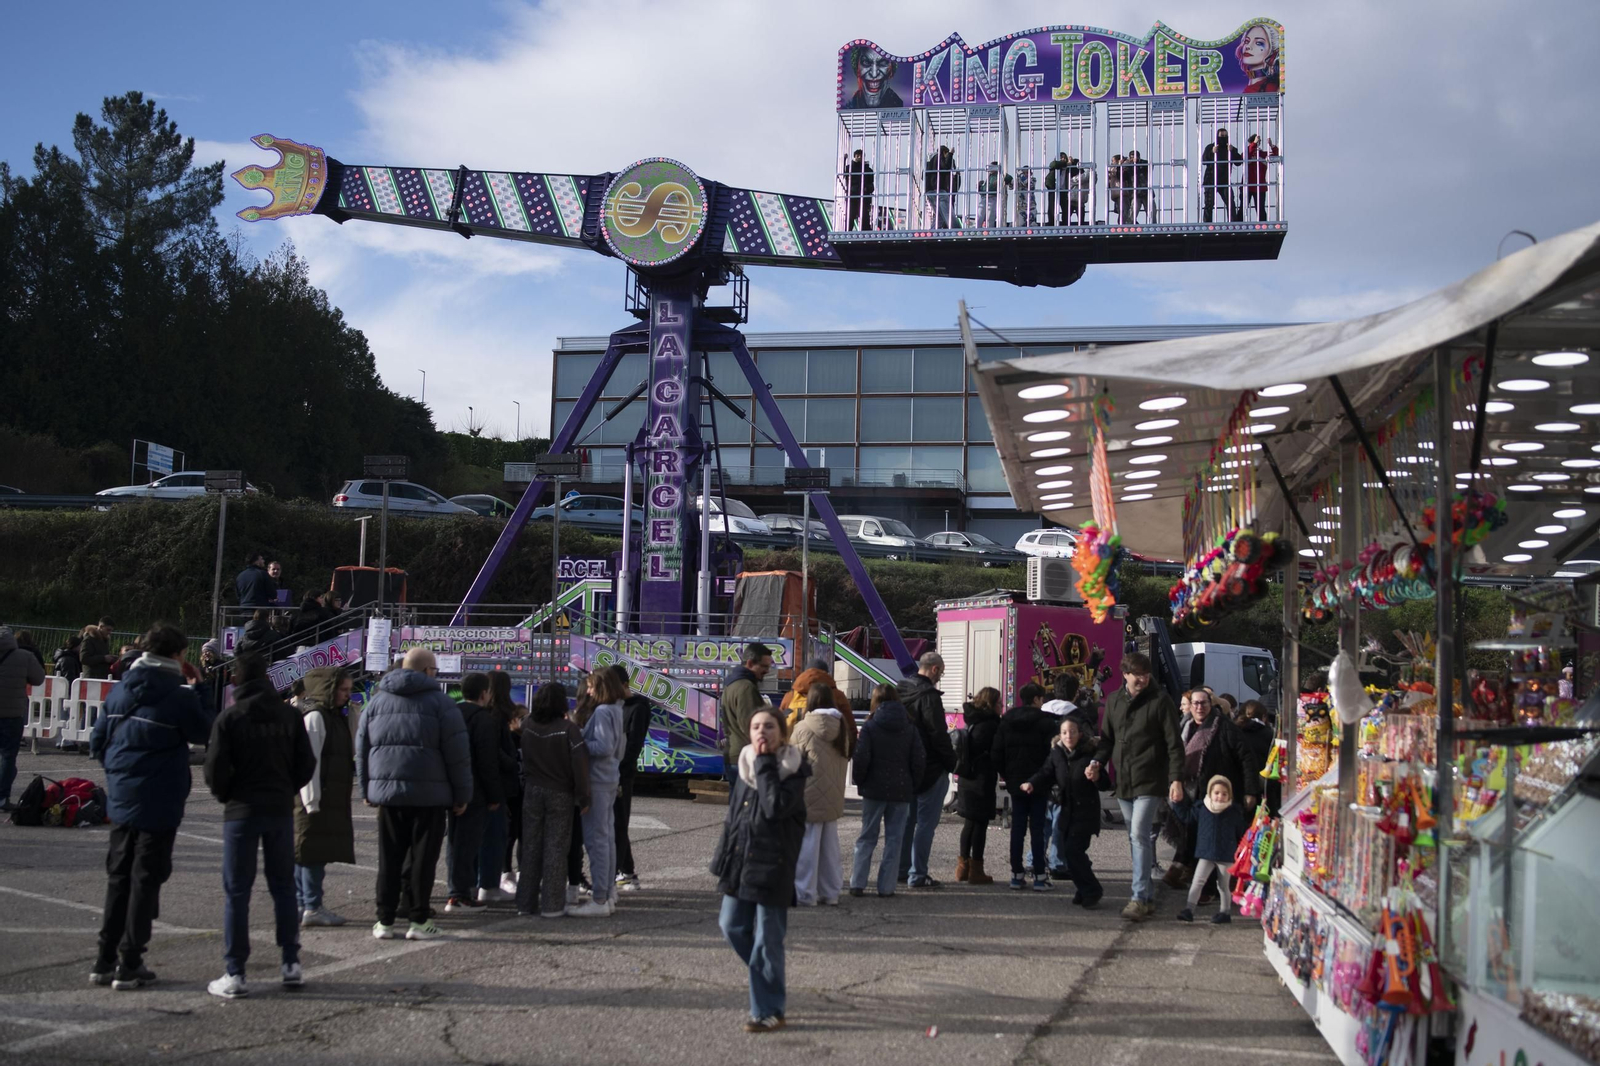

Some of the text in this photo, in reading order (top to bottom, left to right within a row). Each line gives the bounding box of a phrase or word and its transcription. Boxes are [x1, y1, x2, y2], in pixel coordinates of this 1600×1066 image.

[913, 30, 1225, 105] KING JOKER
[274, 153, 305, 203] THE KING
[648, 301, 685, 580] LA CARCEL
[557, 560, 611, 578] RCEL
[423, 629, 515, 638] ATRACCIONES
[681, 641, 786, 664] JOKR
